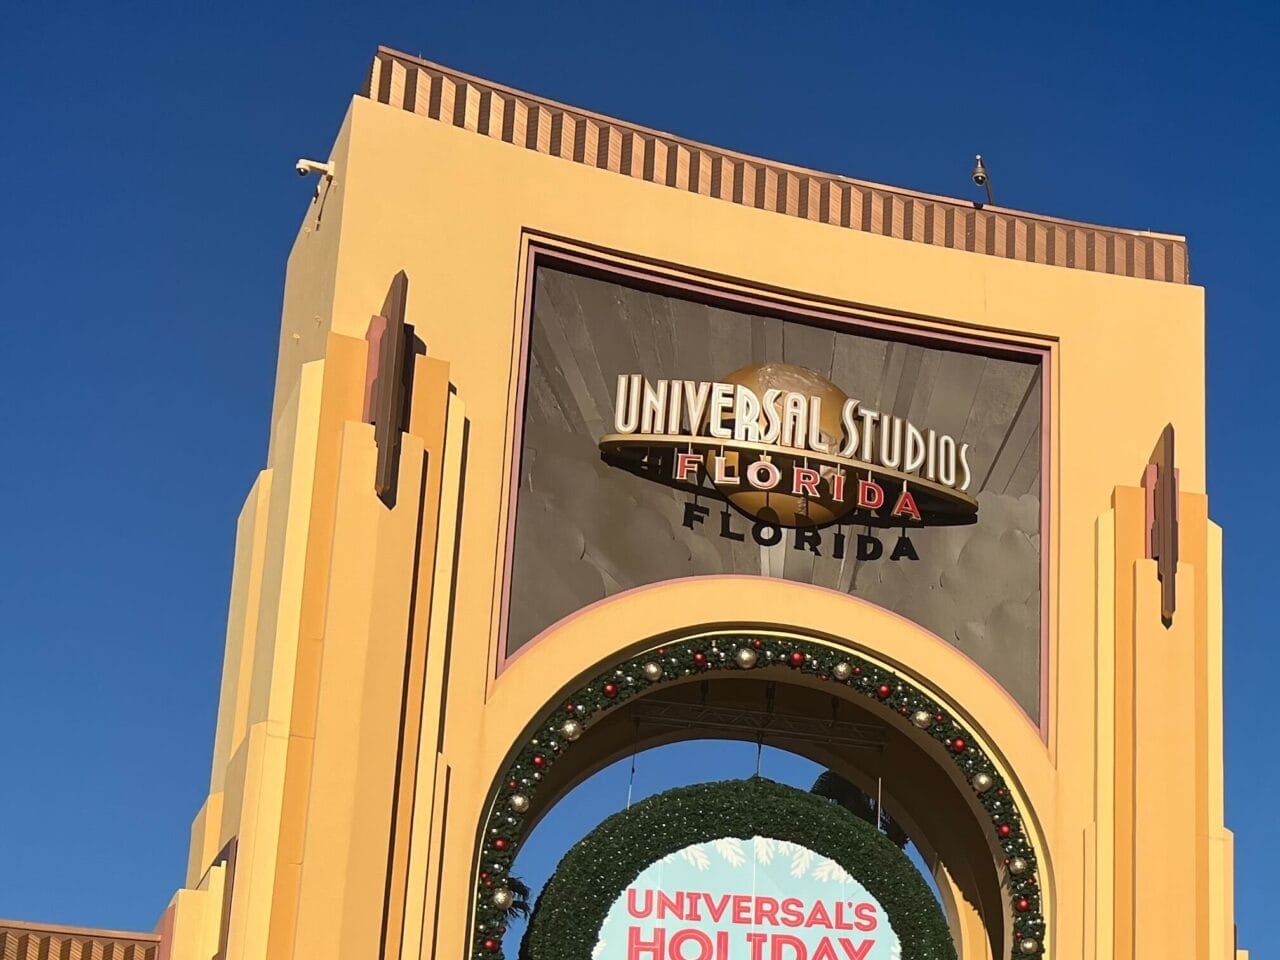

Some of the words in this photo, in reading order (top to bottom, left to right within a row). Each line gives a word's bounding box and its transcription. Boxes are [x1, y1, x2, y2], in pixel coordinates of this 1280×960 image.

[615, 373, 829, 452] UNIVERSAL
[836, 398, 972, 490] STUDIOS
[675, 453, 922, 521] FLORIDA
[626, 888, 878, 931] UNIVERSAL'S
